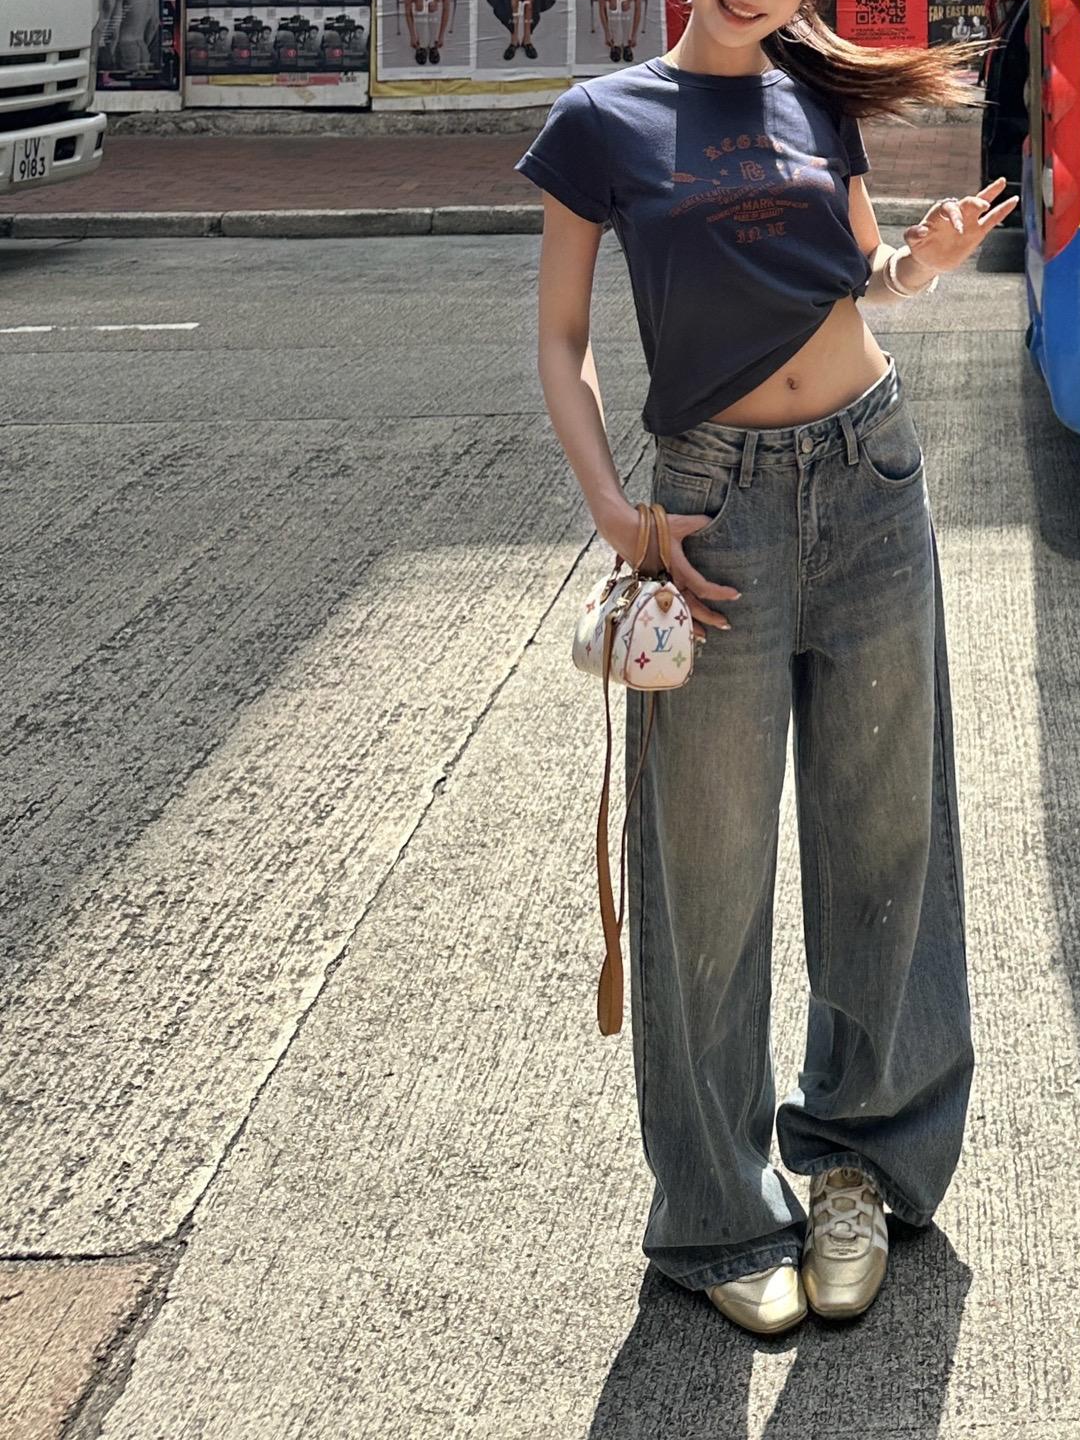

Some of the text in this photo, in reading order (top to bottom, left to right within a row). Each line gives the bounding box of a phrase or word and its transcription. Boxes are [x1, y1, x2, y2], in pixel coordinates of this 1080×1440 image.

[929, 5, 944, 22] FAR
[945, 4, 966, 18] EAST
[9, 28, 53, 48] ISUZU
[19, 156, 46, 180] 9183
[651, 626, 674, 653] LV
